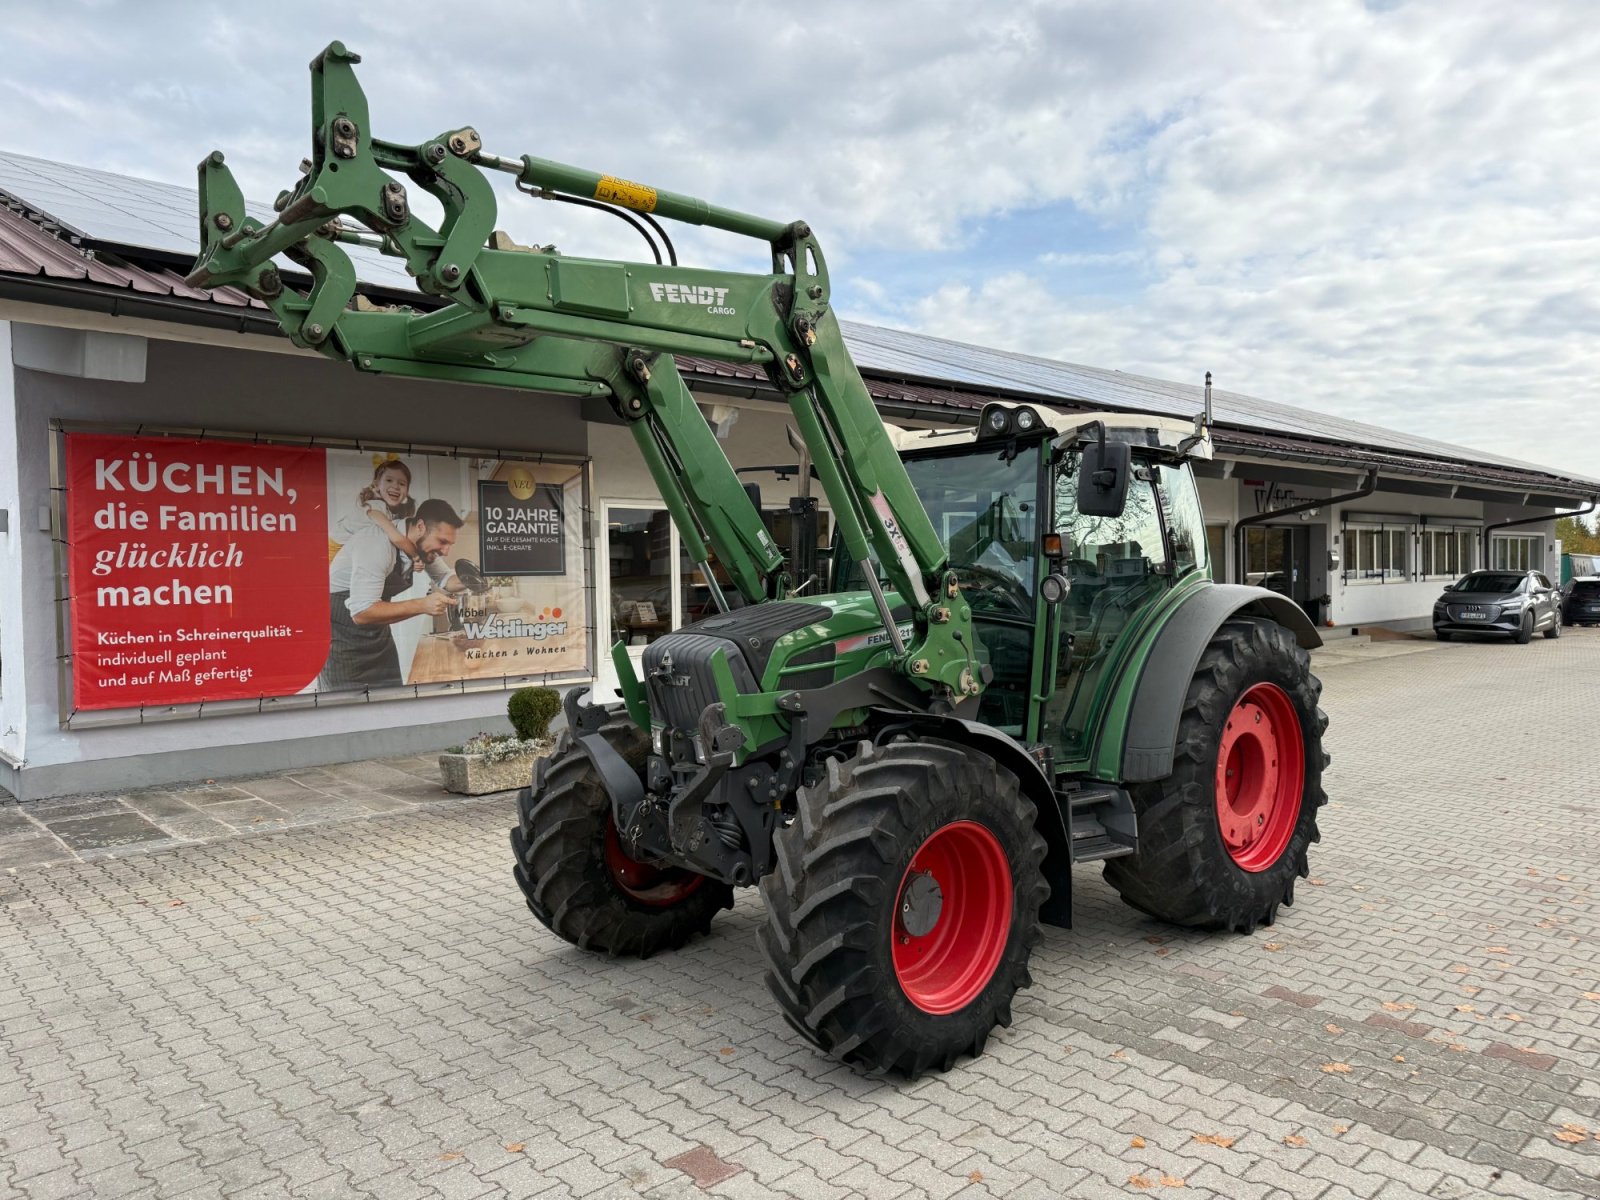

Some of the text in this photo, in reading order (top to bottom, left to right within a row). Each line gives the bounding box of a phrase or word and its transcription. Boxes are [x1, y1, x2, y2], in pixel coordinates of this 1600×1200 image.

[649, 283, 729, 306] FENDT
[707, 306, 736, 315] CARGO
[95, 452, 297, 504] KÜCHEN,
[94, 502, 297, 532] die Familien
[485, 507, 559, 522] 10 JAHRE
[486, 521, 559, 535] GARANTIE
[92, 542, 243, 576] glücklich
[98, 579, 233, 607] machen
[455, 608, 487, 618] Möbel
[98, 631, 154, 645] Küchen
[158, 630, 172, 643] in
[176, 625, 292, 643] Schreinerqualität
[464, 613, 567, 640] Weidinger
[867, 627, 914, 645] FEND 21
[98, 649, 227, 667] individuell geplant
[467, 650, 507, 660] Küchen
[526, 646, 566, 656] Wohnen
[98, 667, 253, 688] und auf Maß gefertigt
